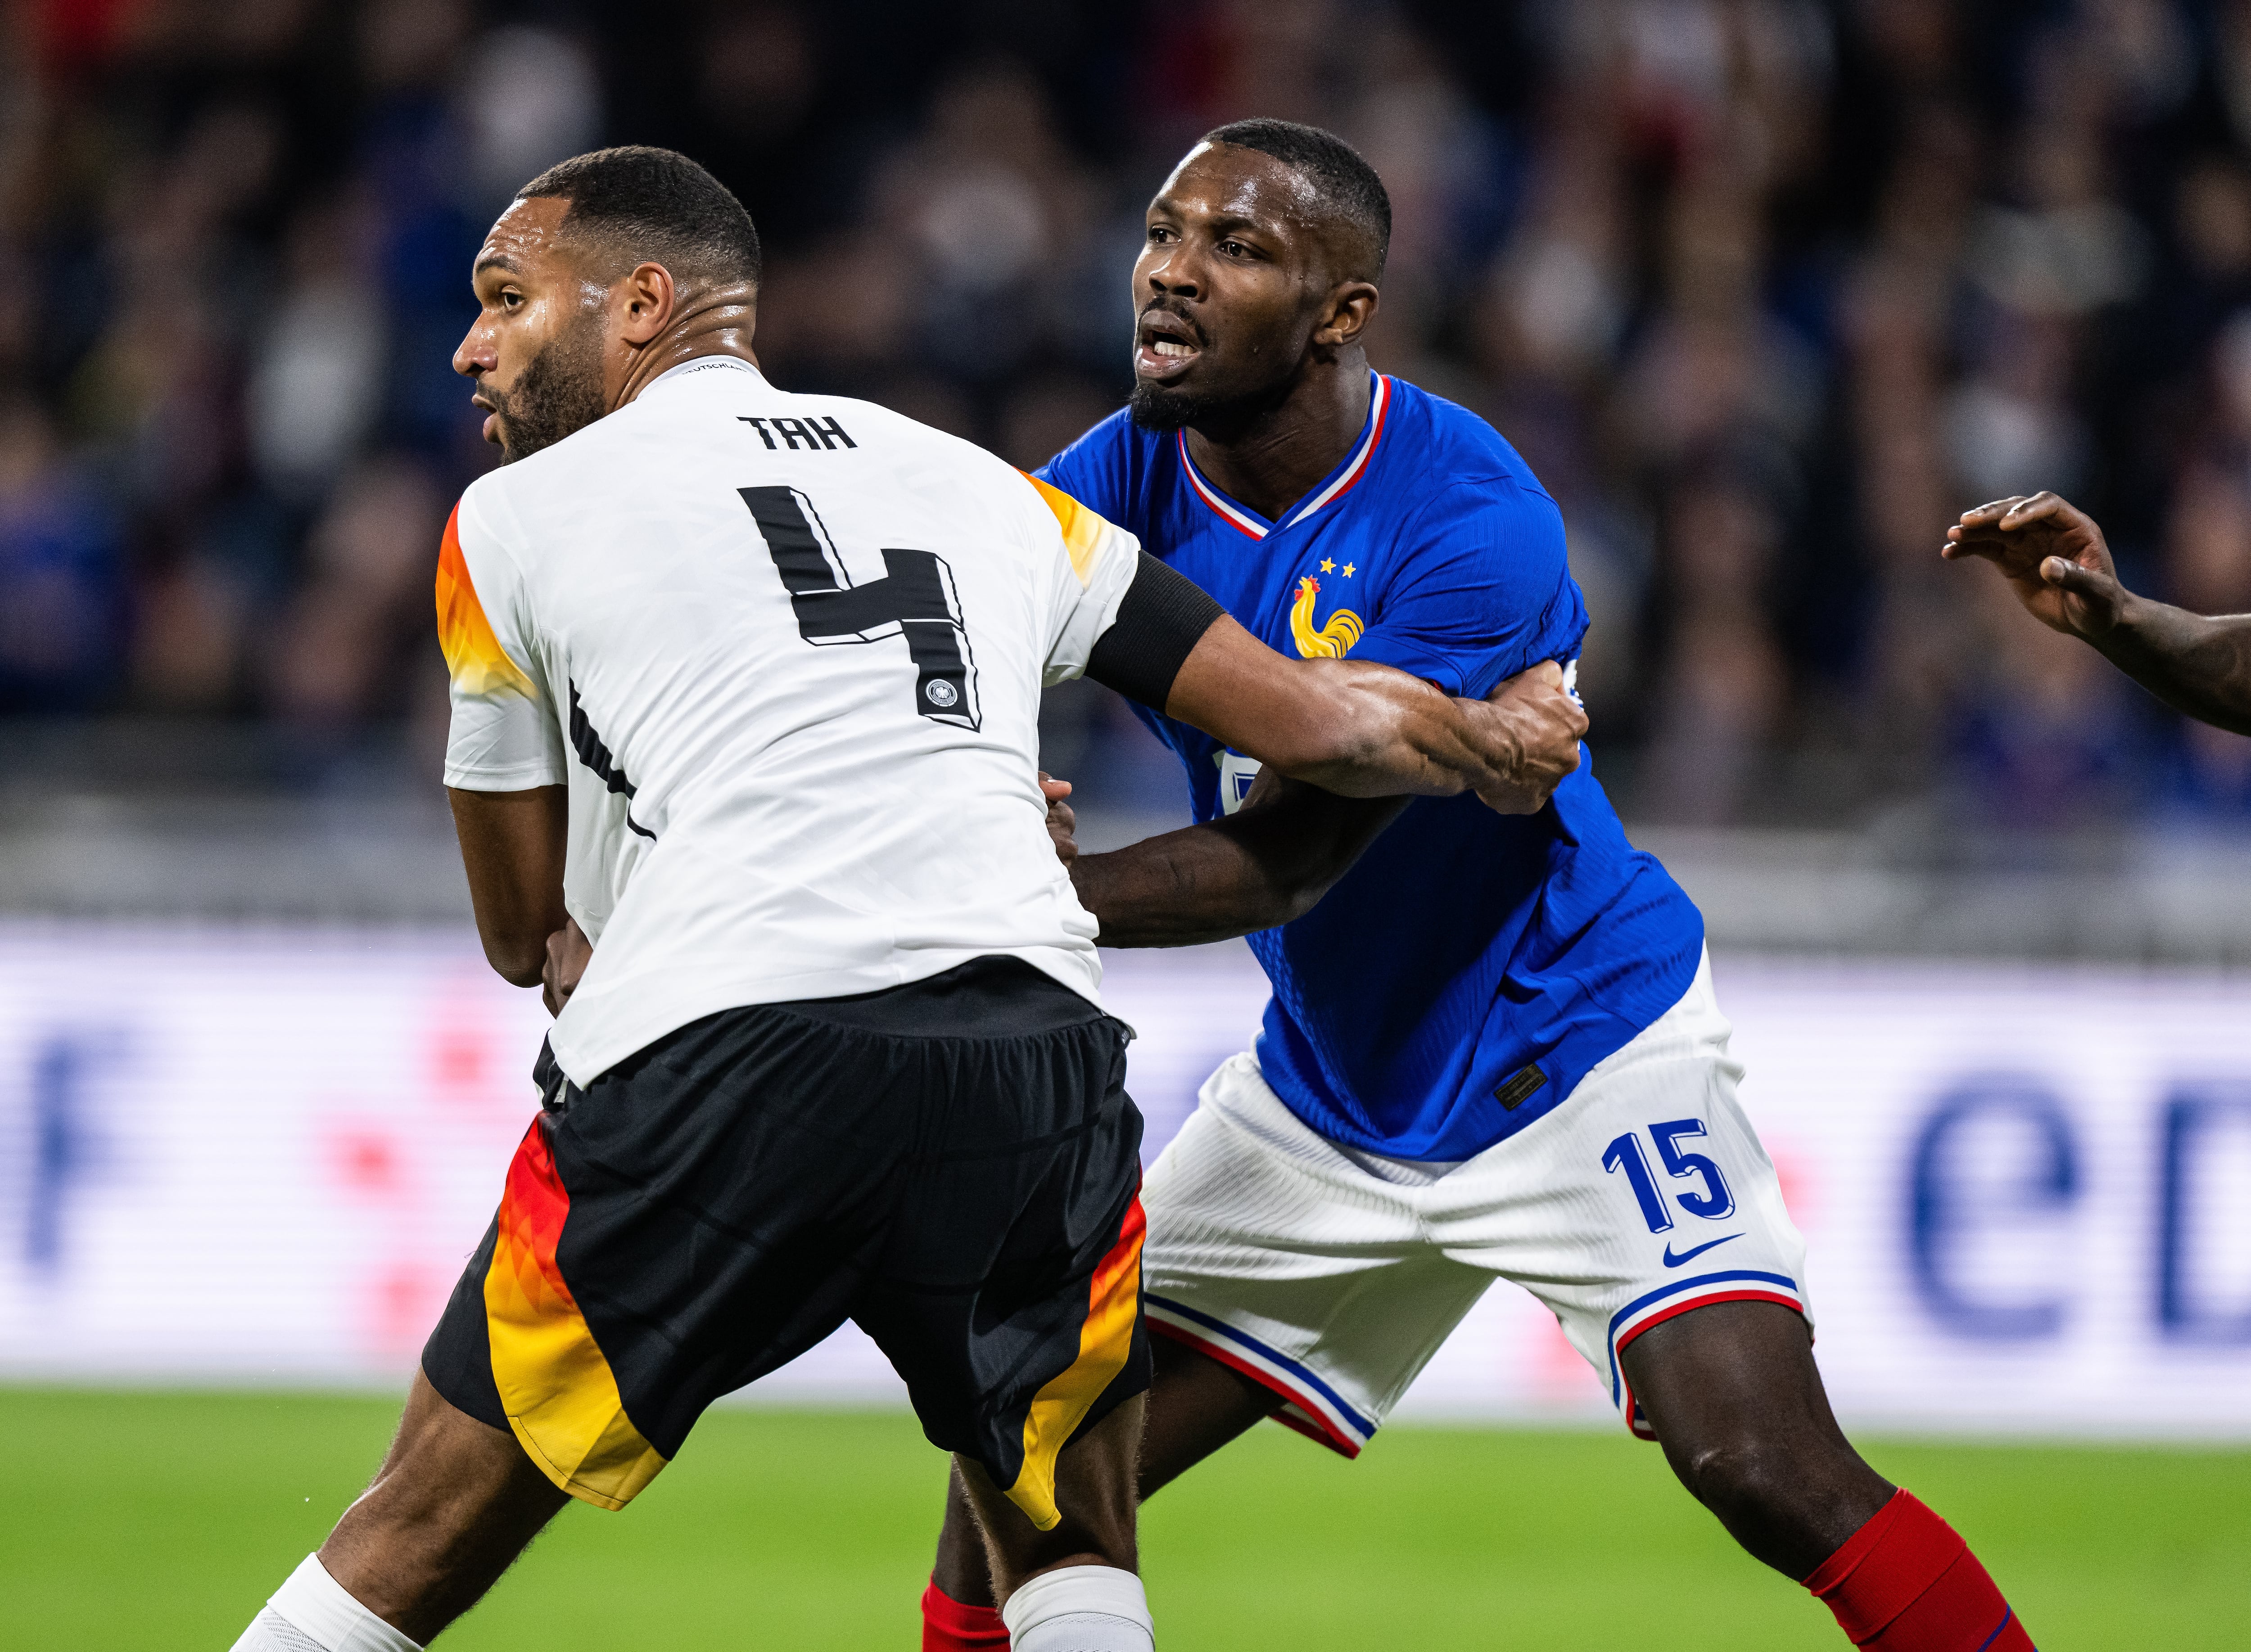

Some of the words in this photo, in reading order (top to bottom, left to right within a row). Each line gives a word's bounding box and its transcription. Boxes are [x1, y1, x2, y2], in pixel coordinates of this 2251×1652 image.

[736, 416, 858, 450] TAH
[736, 485, 982, 733] 4
[1601, 1118, 1736, 1234] 15
